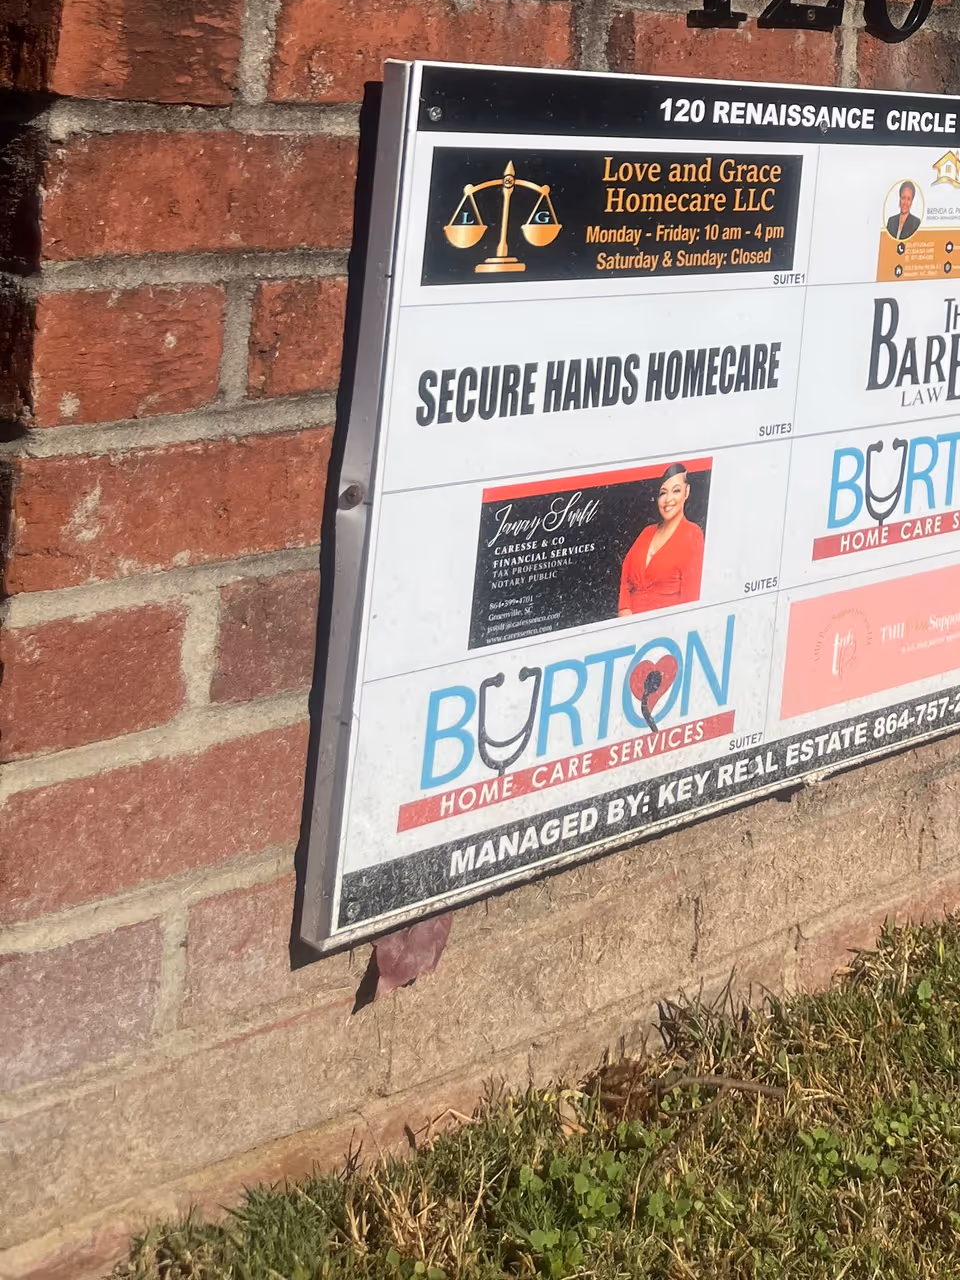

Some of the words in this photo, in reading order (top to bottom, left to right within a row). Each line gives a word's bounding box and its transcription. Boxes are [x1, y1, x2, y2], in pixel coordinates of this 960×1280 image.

[660, 98, 705, 122] 120
[713, 100, 875, 130] RENAISSANCE
[887, 110, 957, 133] CIRCLE
[603, 157, 661, 183] Love
[669, 158, 712, 183] and
[719, 159, 782, 184] Grace
[604, 188, 727, 213] Homecare
[733, 188, 776, 212] LLC
[462, 212, 474, 224] L
[534, 211, 550, 223] G
[586, 225, 641, 245] Monday
[656, 225, 701, 244] Friday:
[704, 225, 719, 241] 10
[722, 228, 742, 241] am
[754, 224, 763, 240] 4
[764, 227, 785, 241] pm
[596, 252, 658, 272] Saturday
[661, 252, 673, 267] &
[676, 249, 728, 269] Sunday:
[730, 248, 772, 266] Closed
[415, 362, 538, 427] SECURE
[542, 353, 640, 414] HANDS
[644, 341, 782, 403] HOMECARE
[901, 385, 943, 407] LAW
[758, 423, 792, 438] SUITE3
[494, 540, 538, 556] CARESSE
[541, 539, 549, 548] &
[551, 536, 565, 546] CO
[840, 525, 889, 553] HOME
[901, 516, 942, 540] CARE
[493, 551, 548, 569] FINANCIAL
[550, 543, 595, 559] SERVICES
[491, 576, 526, 590] NOTARY
[528, 570, 558, 583] PUBLIC
[492, 568, 509, 579] TAX
[512, 558, 573, 576] PROFESSIONAL
[744, 576, 778, 594] SUITE5
[420, 614, 736, 792] BURTON
[728, 732, 763, 751] SUITE7
[438, 775, 514, 817] HOME
[532, 753, 593, 790] CARE
[609, 721, 705, 767] SERVICES
[450, 807, 599, 877] MANAGED
[607, 791, 650, 823] BY:
[658, 771, 715, 808] KEY
[717, 752, 779, 790] REAL
[784, 722, 869, 767] ESTATE
